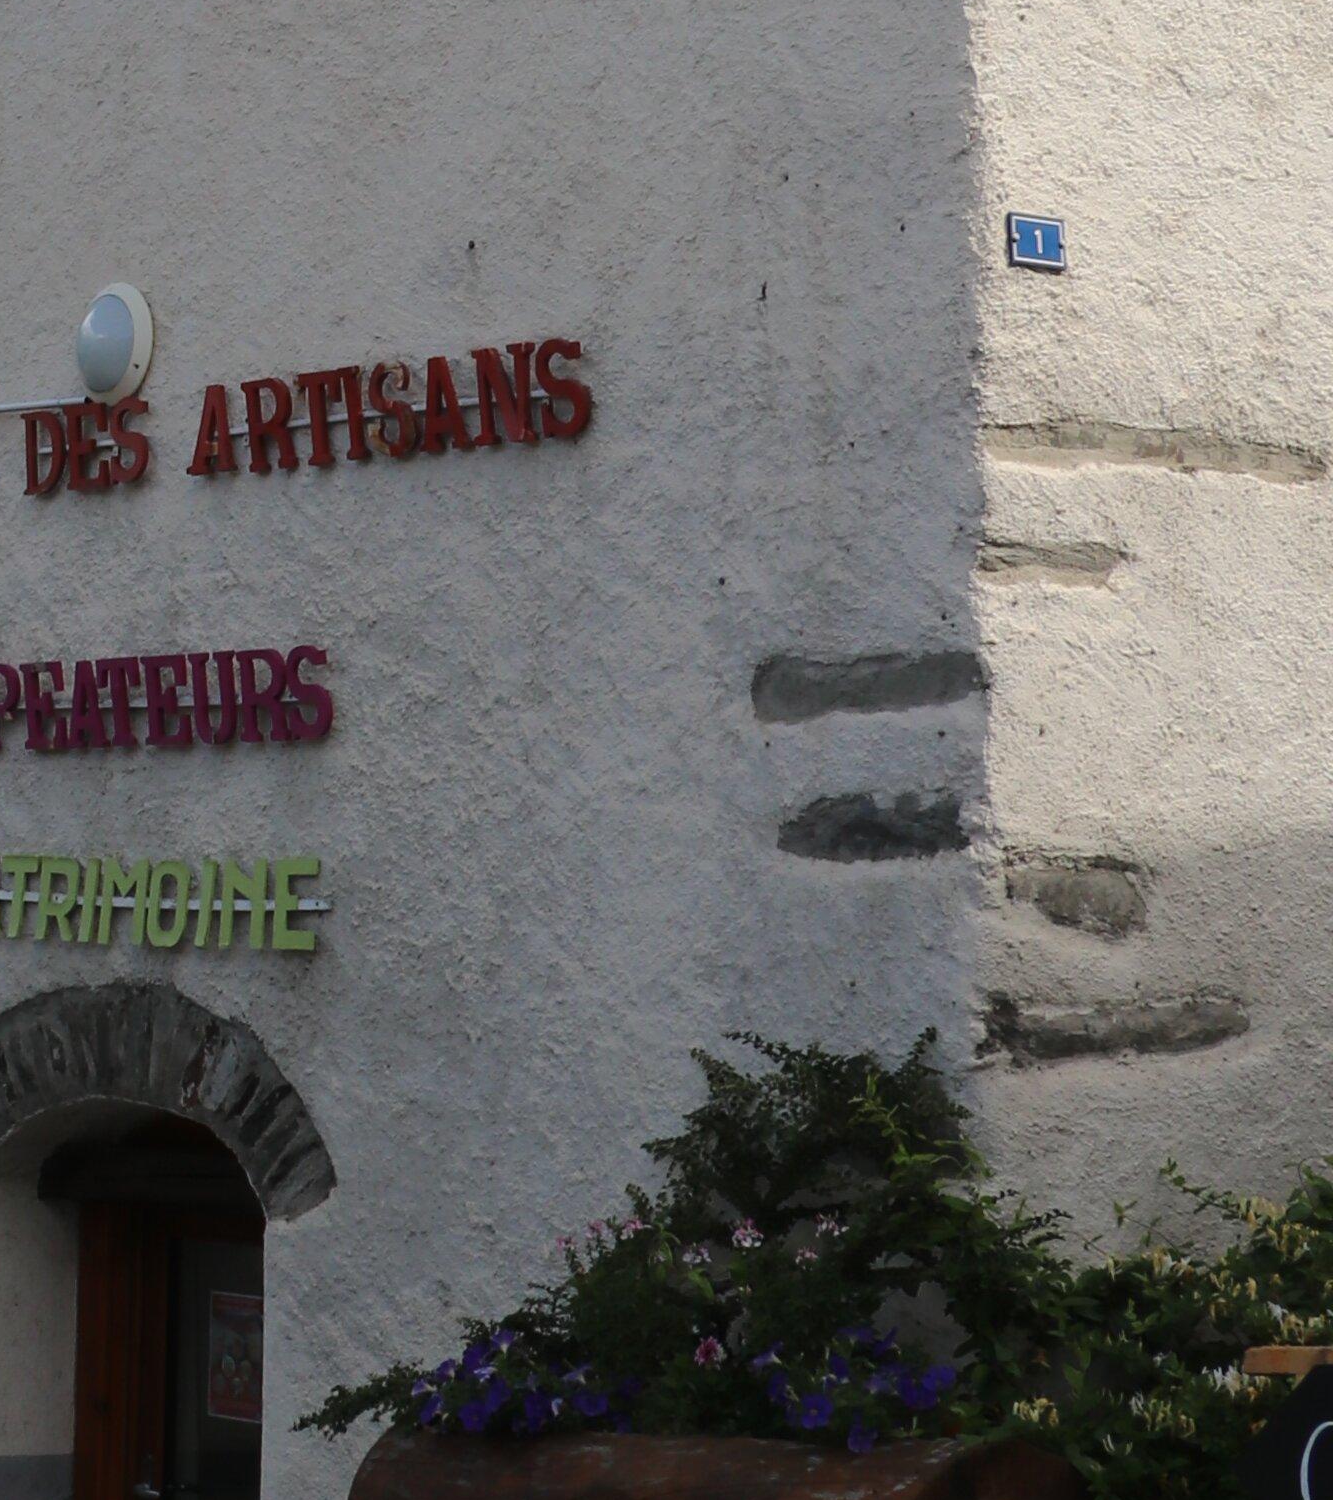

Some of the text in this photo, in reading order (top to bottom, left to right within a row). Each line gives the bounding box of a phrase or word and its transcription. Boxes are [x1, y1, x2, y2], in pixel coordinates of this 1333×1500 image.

[1034, 229, 1044, 255] 1
[20, 395, 149, 497] DES
[186, 337, 594, 476] ARTISANS
